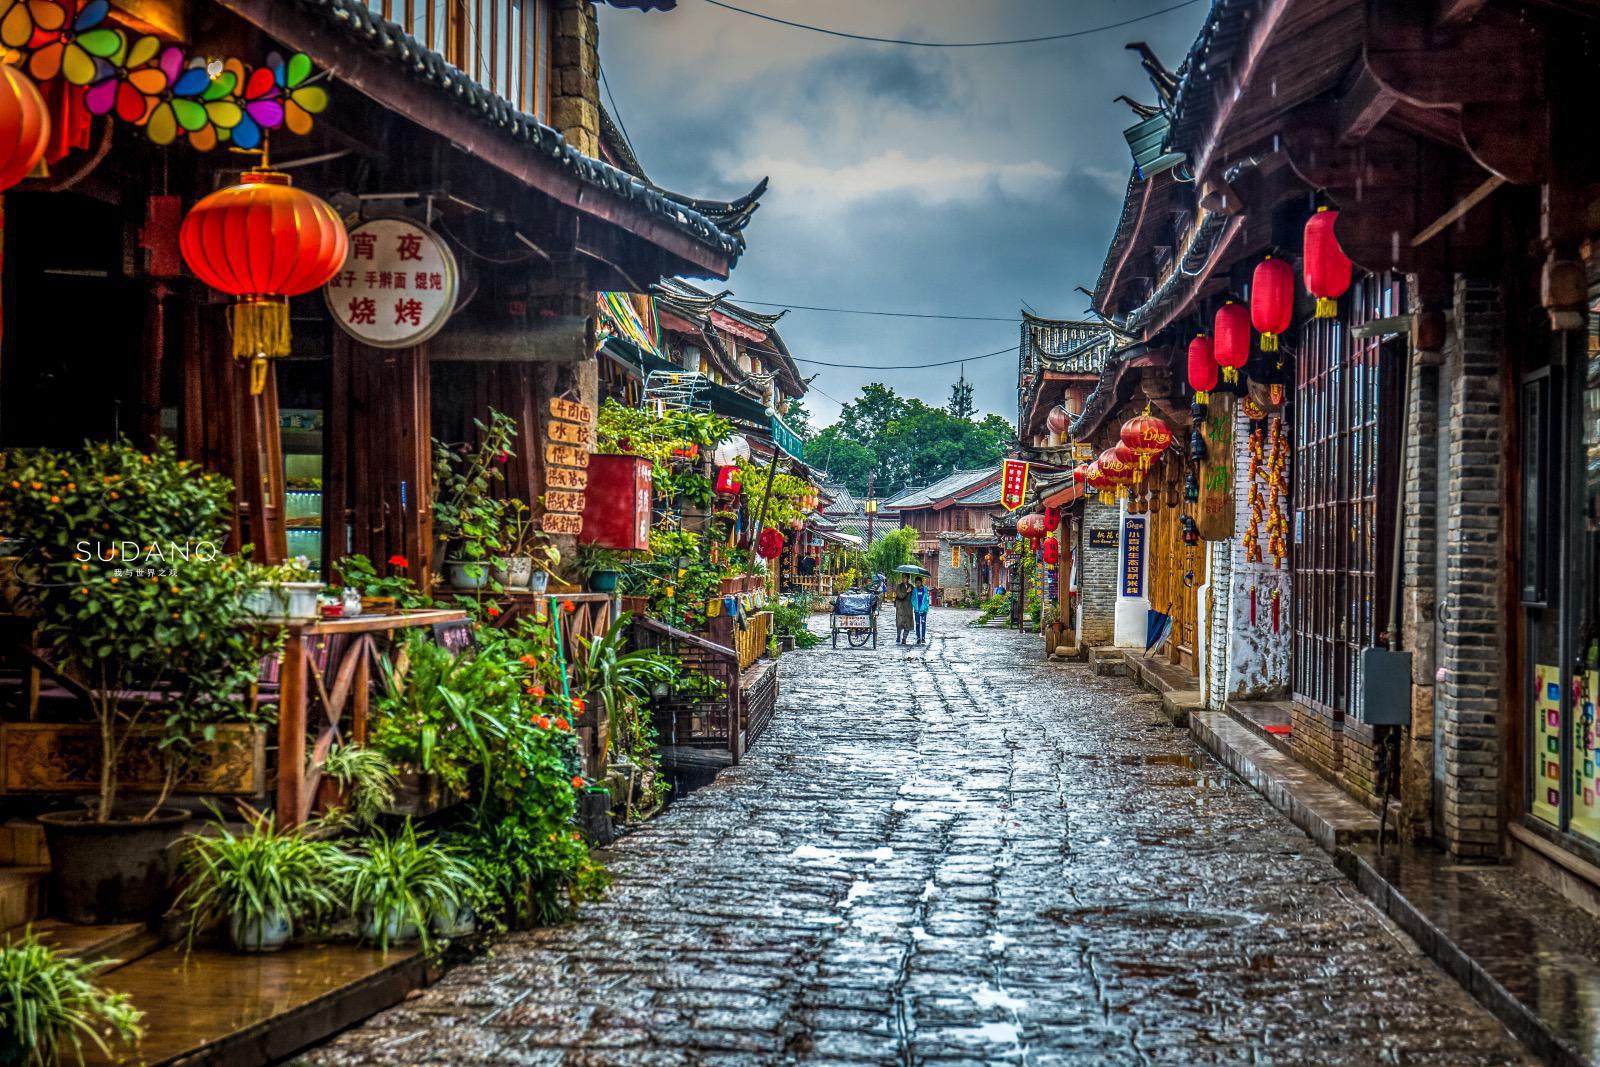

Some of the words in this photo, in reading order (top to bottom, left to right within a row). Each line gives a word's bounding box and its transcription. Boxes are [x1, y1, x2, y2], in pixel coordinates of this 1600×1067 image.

[351, 232, 423, 262] 宵夜
[364, 271, 406, 289] 手擀面
[415, 272, 442, 291] 馄饨
[348, 298, 422, 326] 烧烤
[556, 401, 591, 422] 牛肉面
[555, 423, 590, 444] 水饺
